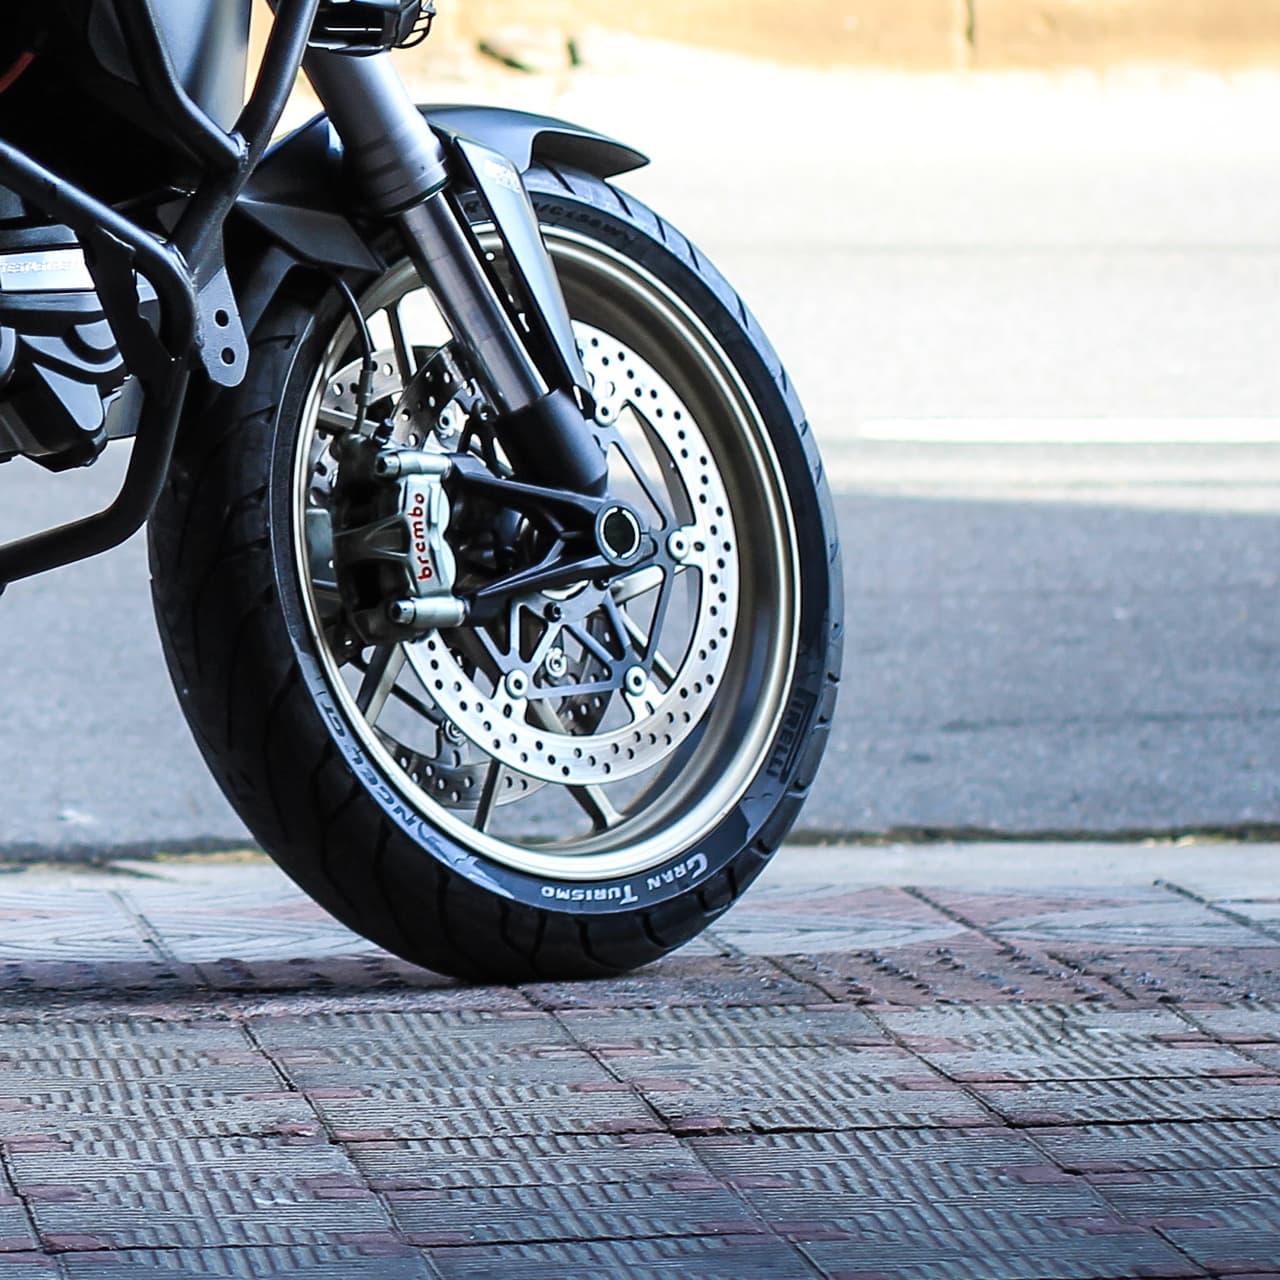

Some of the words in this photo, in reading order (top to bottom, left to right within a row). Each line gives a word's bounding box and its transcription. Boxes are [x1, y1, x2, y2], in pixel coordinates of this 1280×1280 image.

[407, 493, 433, 582] brembo
[321, 702, 345, 737] GT
[351, 747, 454, 864] ANGEL
[647, 852, 708, 890] GRAN
[541, 885, 638, 905] TURISMO
